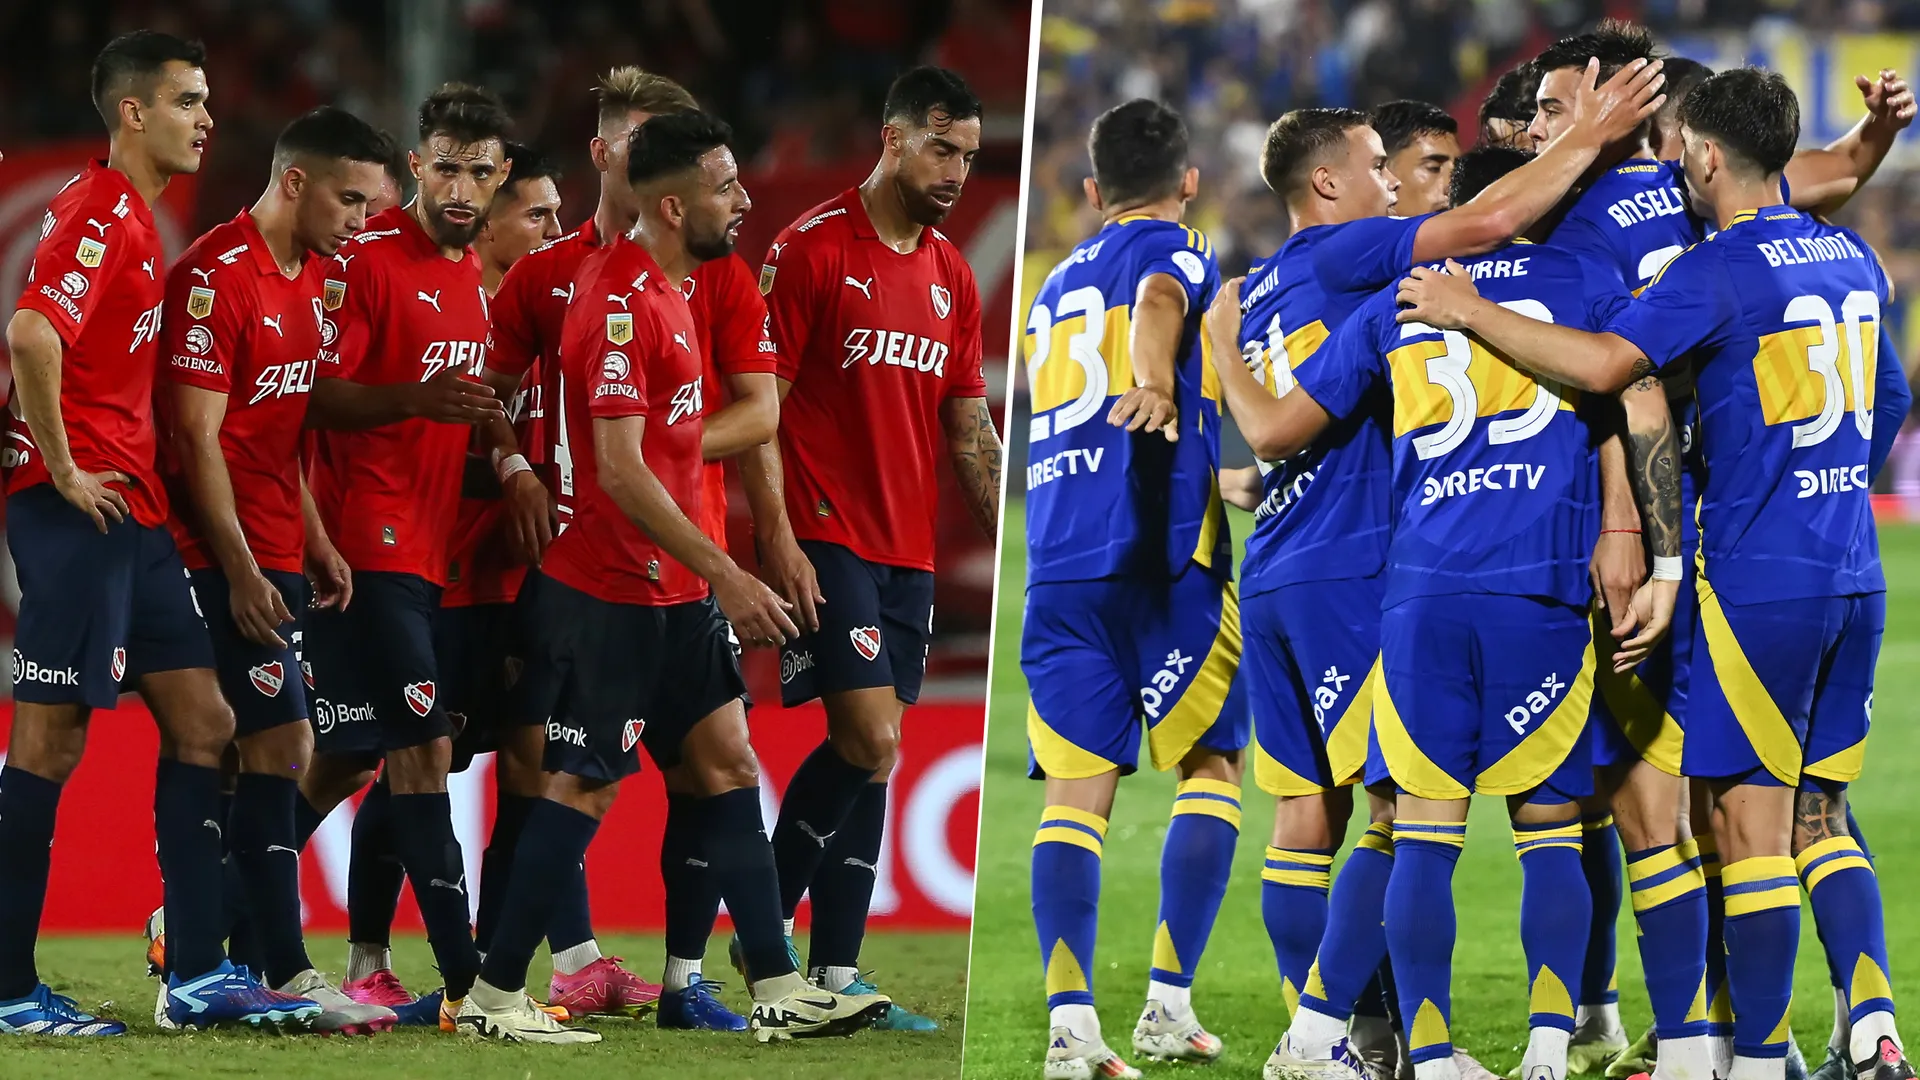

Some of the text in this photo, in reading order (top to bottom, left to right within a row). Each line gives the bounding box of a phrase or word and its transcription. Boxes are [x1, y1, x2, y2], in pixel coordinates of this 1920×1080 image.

[40, 285, 84, 324] SCIENZA
[171, 354, 224, 375] SCIENZA
[1783, 290, 1881, 450] 30
[594, 382, 639, 400] SCIENZA
[1026, 447, 1105, 491] IRECTV
[1420, 463, 1547, 506] DIRECTV
[1793, 464, 1869, 499] DIREC
[25, 660, 80, 686] Bank
[1140, 648, 1193, 718] pax
[336, 702, 377, 723] Bank
[1313, 665, 1351, 734] pax
[1504, 672, 1566, 736] pax
